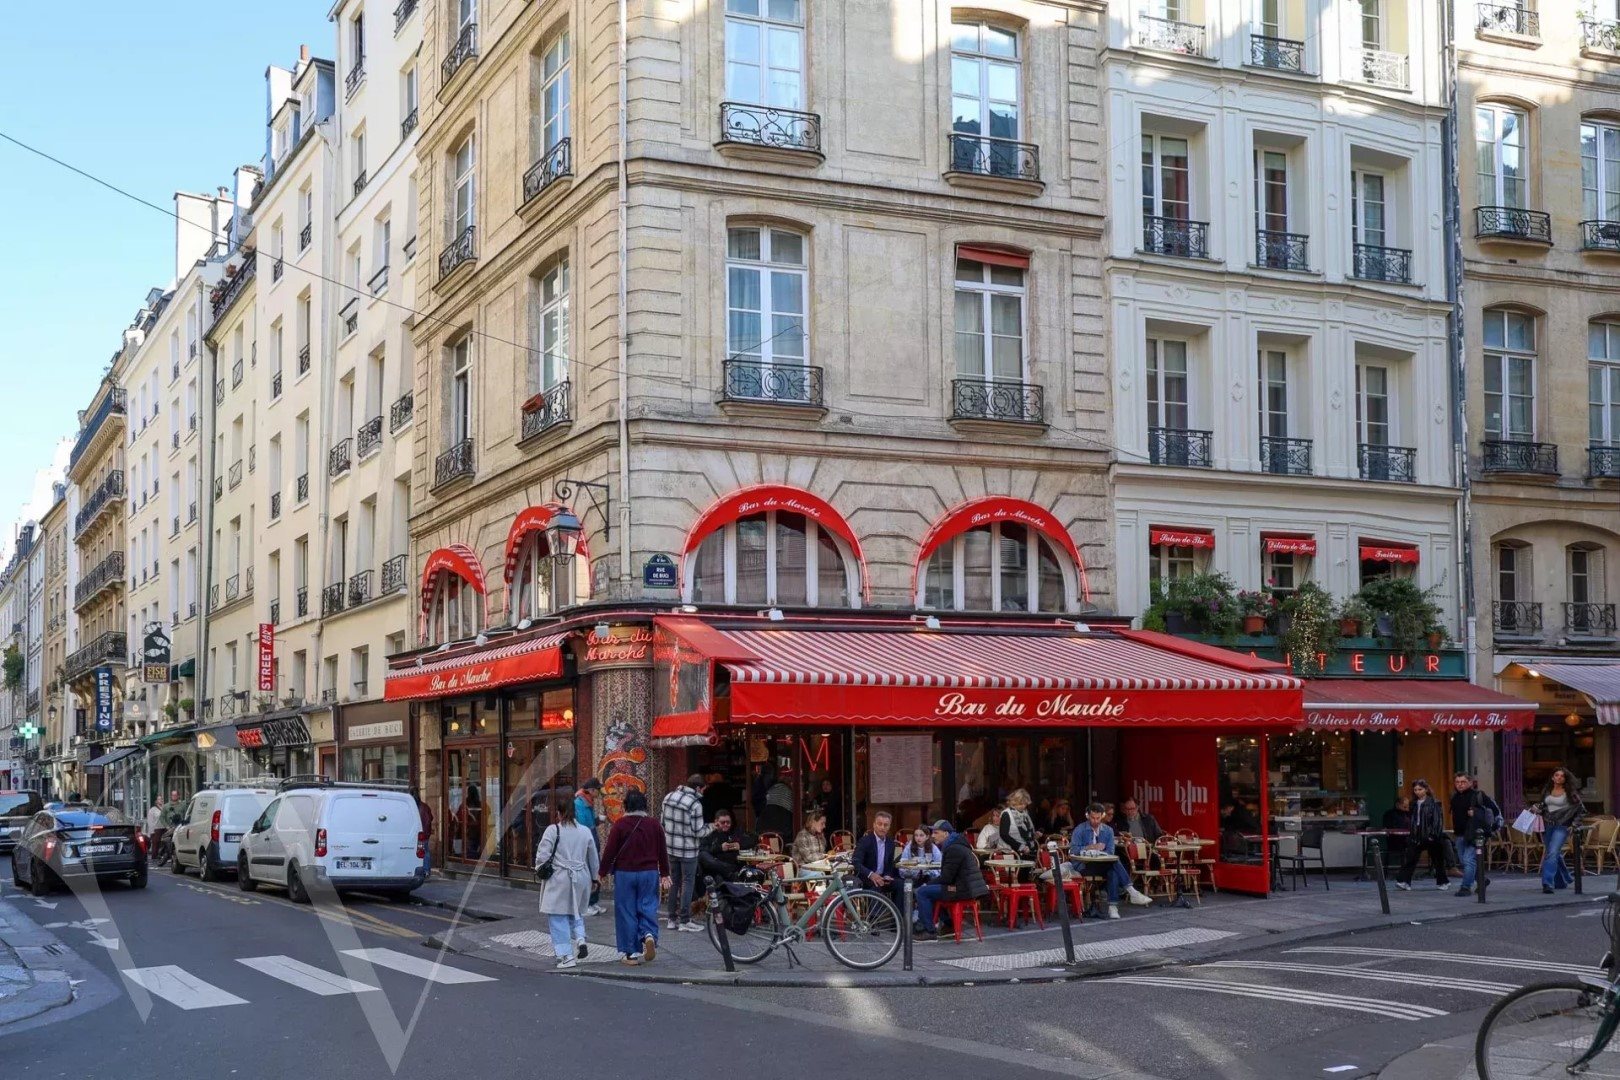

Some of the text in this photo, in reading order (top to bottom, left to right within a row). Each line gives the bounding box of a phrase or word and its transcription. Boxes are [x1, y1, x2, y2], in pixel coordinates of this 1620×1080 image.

[738, 497, 820, 518] Bar du Marché
[971, 512, 990, 524] Bar
[994, 508, 1007, 517] du
[1182, 535, 1191, 544] de
[586, 628, 652, 646] Bar du
[584, 645, 647, 661] Marché
[147, 666, 167, 675] FISH
[261, 646, 272, 690] STREET
[429, 667, 494, 691] Bar du Marché
[98, 672, 111, 727] PRESSING
[935, 692, 1129, 717] Bar du Marché
[1352, 713, 1367, 726] de
[1369, 712, 1400, 726] Buci
[1430, 712, 1508, 726] Salon de Thé
